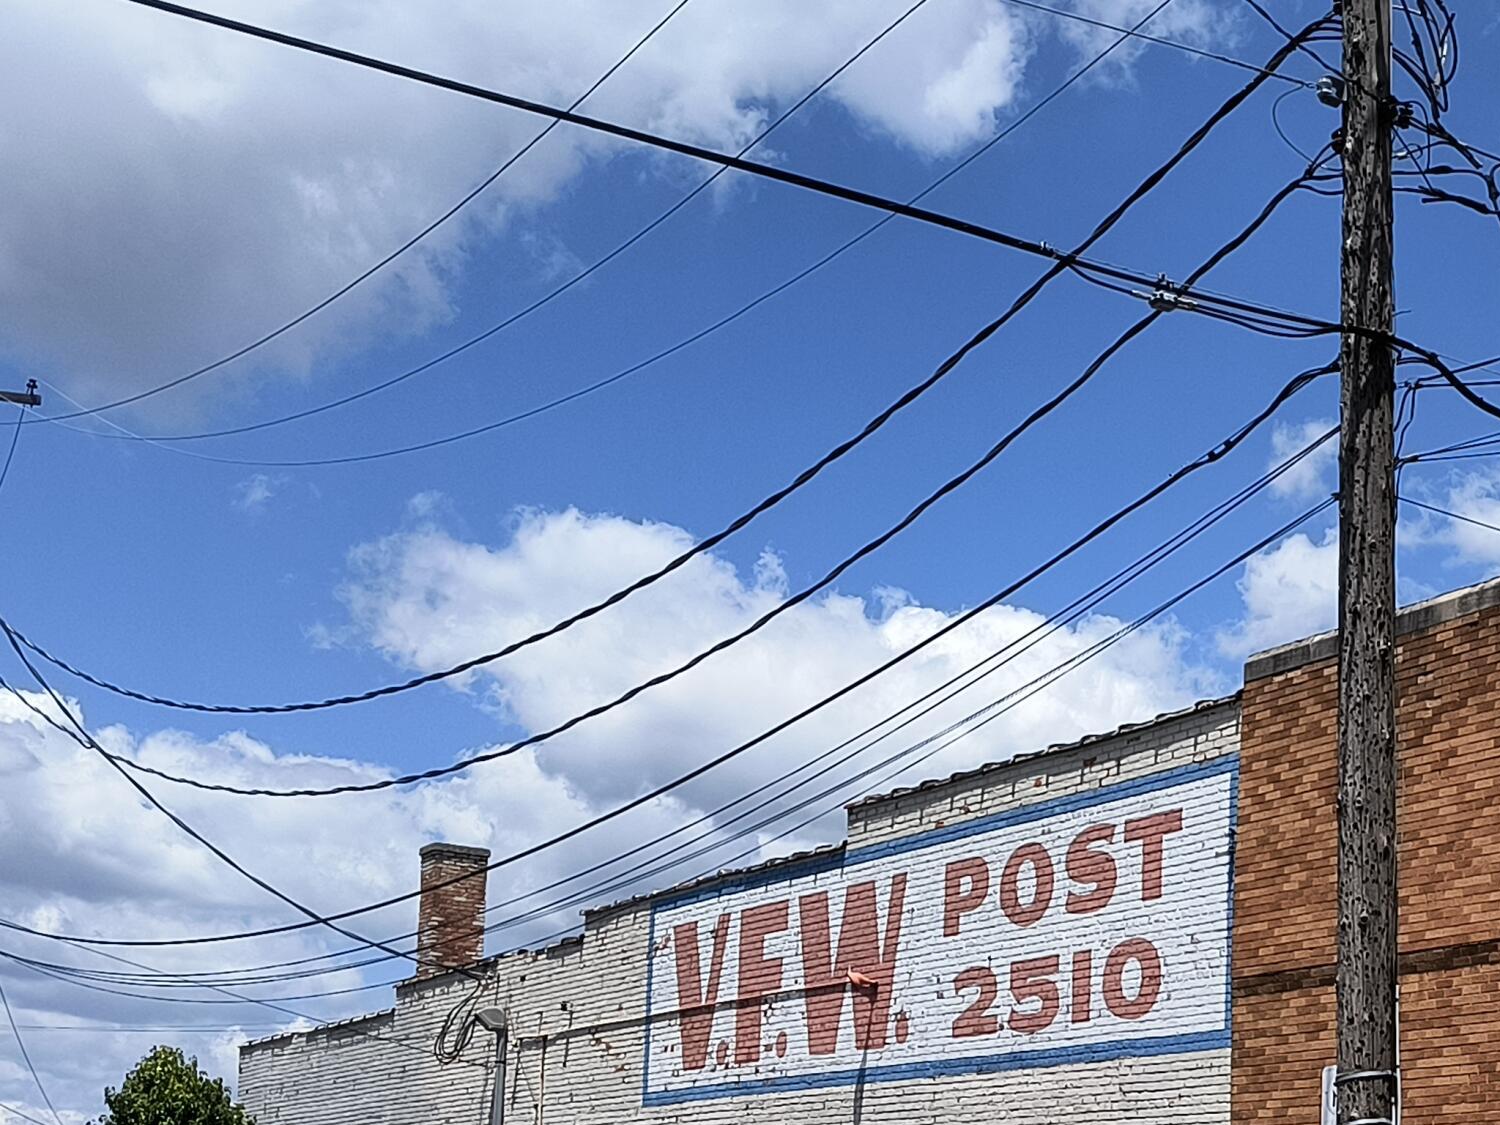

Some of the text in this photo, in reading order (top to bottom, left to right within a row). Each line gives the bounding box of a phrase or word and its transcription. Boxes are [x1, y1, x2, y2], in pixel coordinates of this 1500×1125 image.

[673, 809, 1183, 1071] V.F.W. POST
[951, 937, 1163, 1035] 2510
